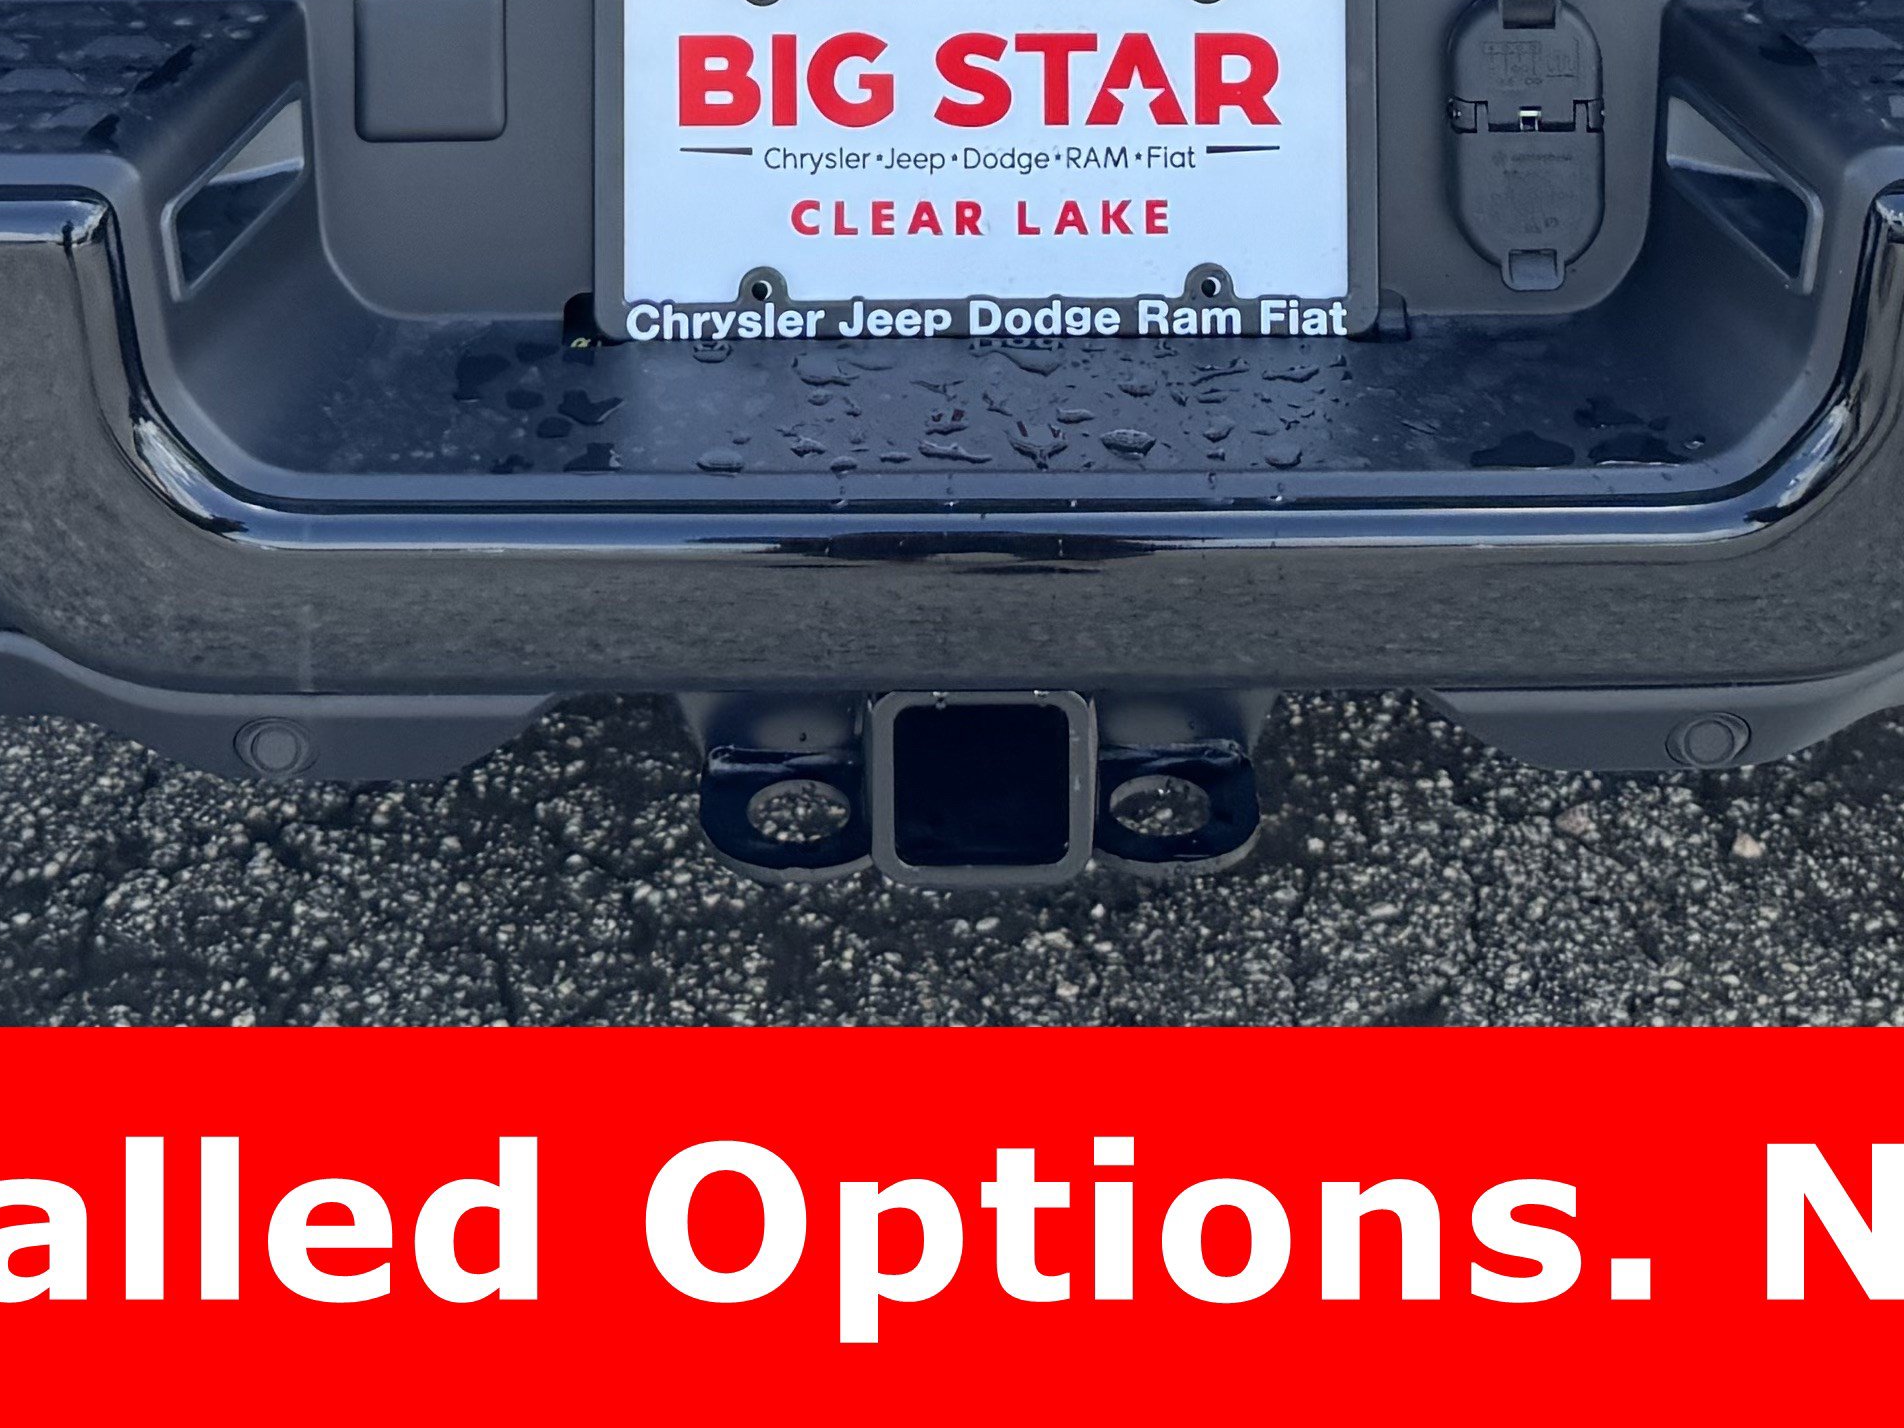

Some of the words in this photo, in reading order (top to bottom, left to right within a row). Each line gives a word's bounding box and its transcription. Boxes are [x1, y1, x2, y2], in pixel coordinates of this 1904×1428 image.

[678, 32, 893, 128] BIG
[935, 32, 1280, 128] STAR
[790, 199, 983, 237] CLEAR
[1017, 199, 1169, 236] LAKE
[626, 302, 826, 340] Chrysler
[838, 300, 952, 338] Jeep
[969, 299, 1121, 337] Dodge
[1138, 299, 1242, 336] Ram
[1260, 299, 1348, 336] Fiat
